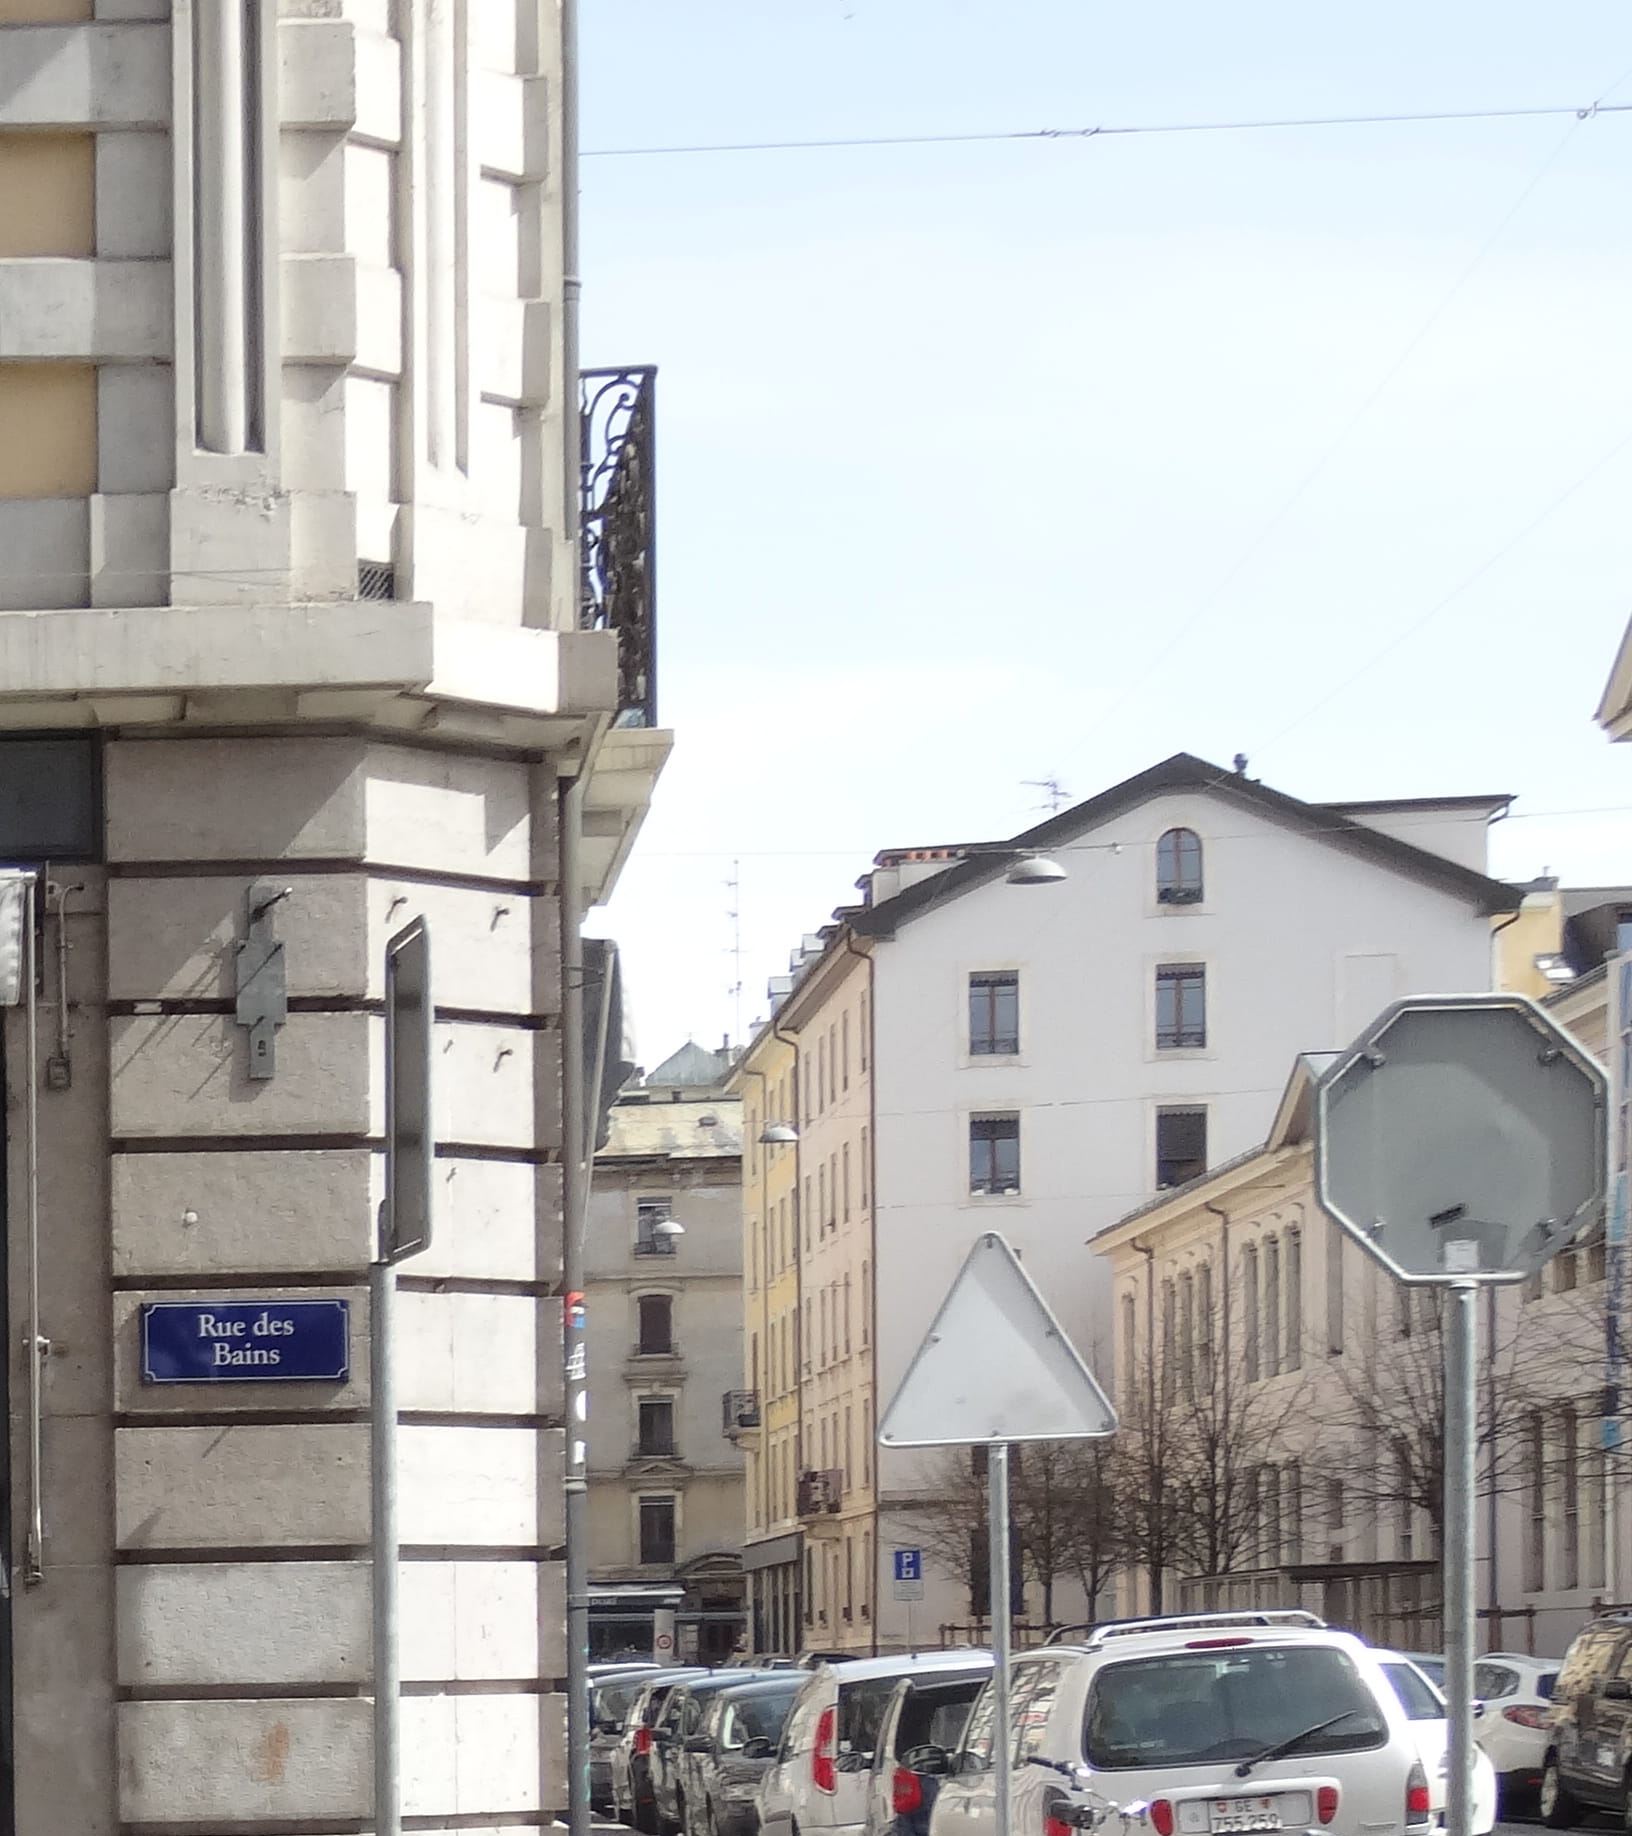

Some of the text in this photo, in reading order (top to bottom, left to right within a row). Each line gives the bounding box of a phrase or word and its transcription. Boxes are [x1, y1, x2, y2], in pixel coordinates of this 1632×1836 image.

[197, 1312, 295, 1338] Rue des
[213, 1342, 281, 1367] Bains
[1235, 1800, 1253, 1813] GE
